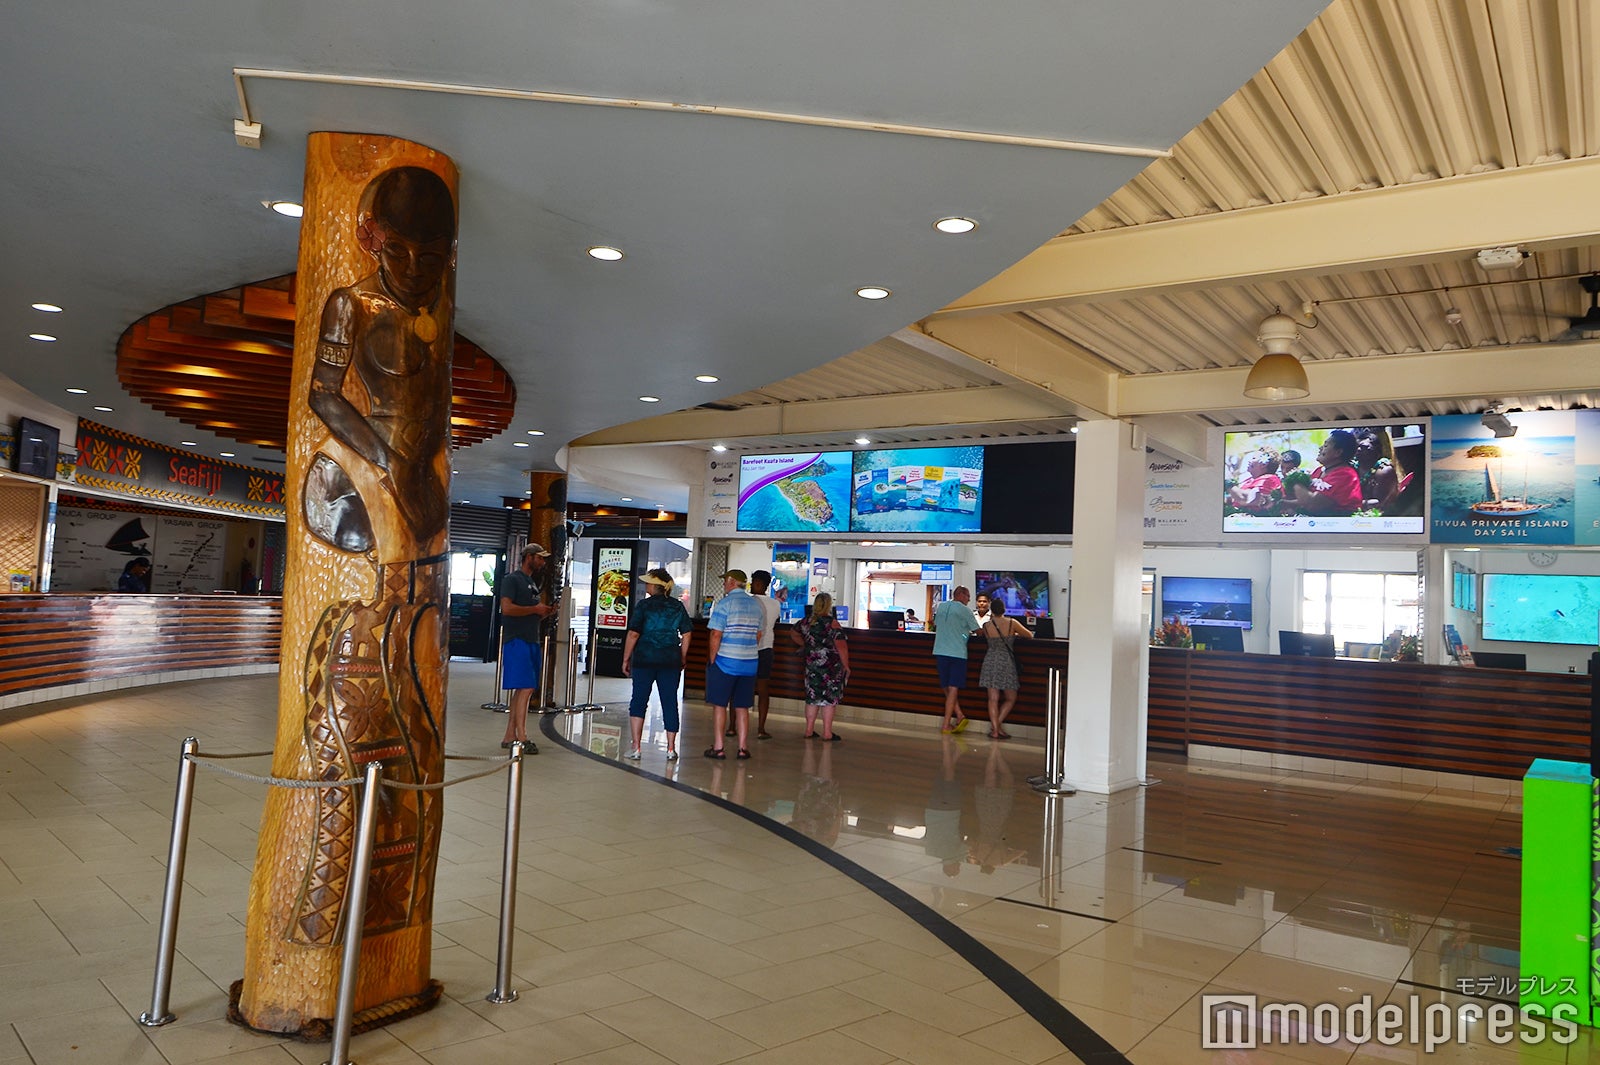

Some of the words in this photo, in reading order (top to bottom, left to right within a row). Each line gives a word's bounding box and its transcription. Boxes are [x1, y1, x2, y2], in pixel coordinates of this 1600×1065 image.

[169, 457, 222, 496] SeaFiji
[86, 511, 117, 520] GROUP
[197, 521, 224, 529] GROUP
[1434, 519, 1467, 528] TIVUA
[1471, 519, 1522, 528] PRIVATE
[1525, 519, 1570, 528] ISLAND
[1474, 528, 1497, 537] DAY
[1500, 528, 1529, 537] SAIL
